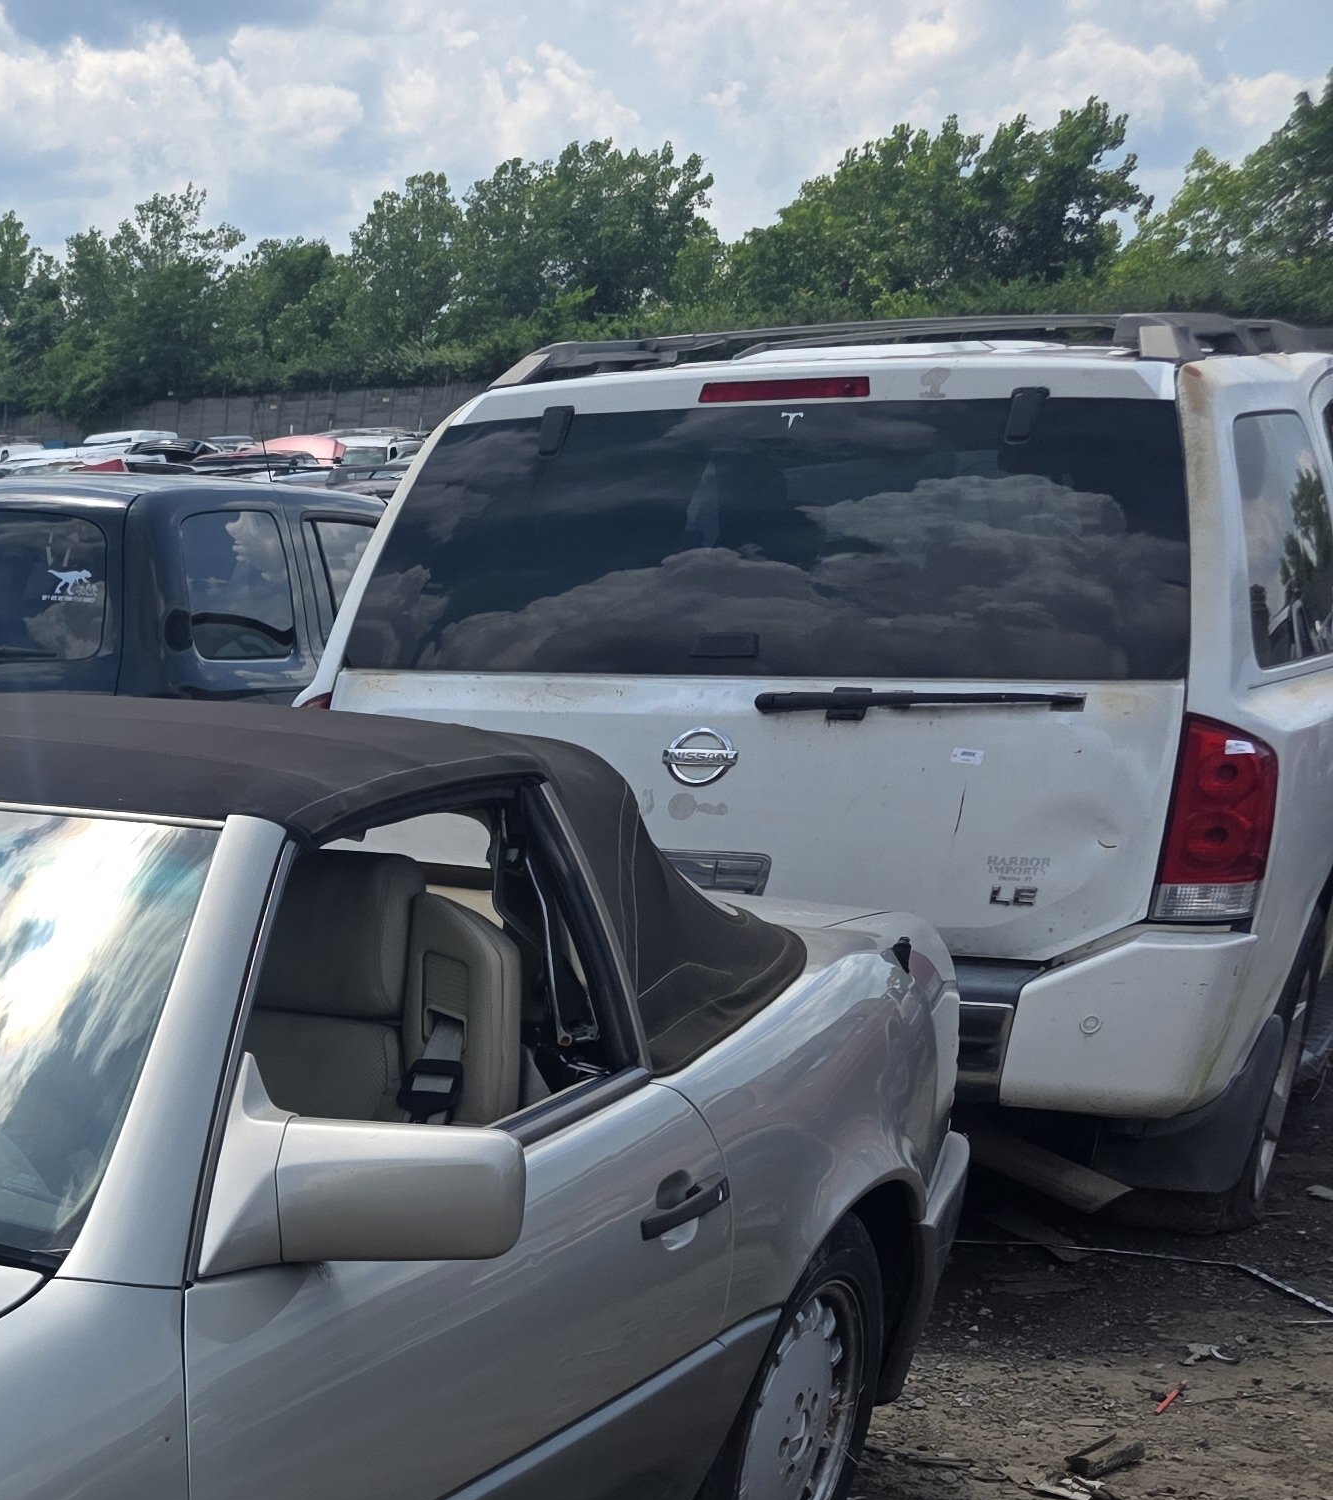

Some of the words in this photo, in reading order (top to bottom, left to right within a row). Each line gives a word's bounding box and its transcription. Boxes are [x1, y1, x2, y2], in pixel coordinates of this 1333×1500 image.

[669, 751, 731, 763] NISSAN
[987, 855, 1051, 868] HARBOR
[989, 884, 1039, 907] LE
